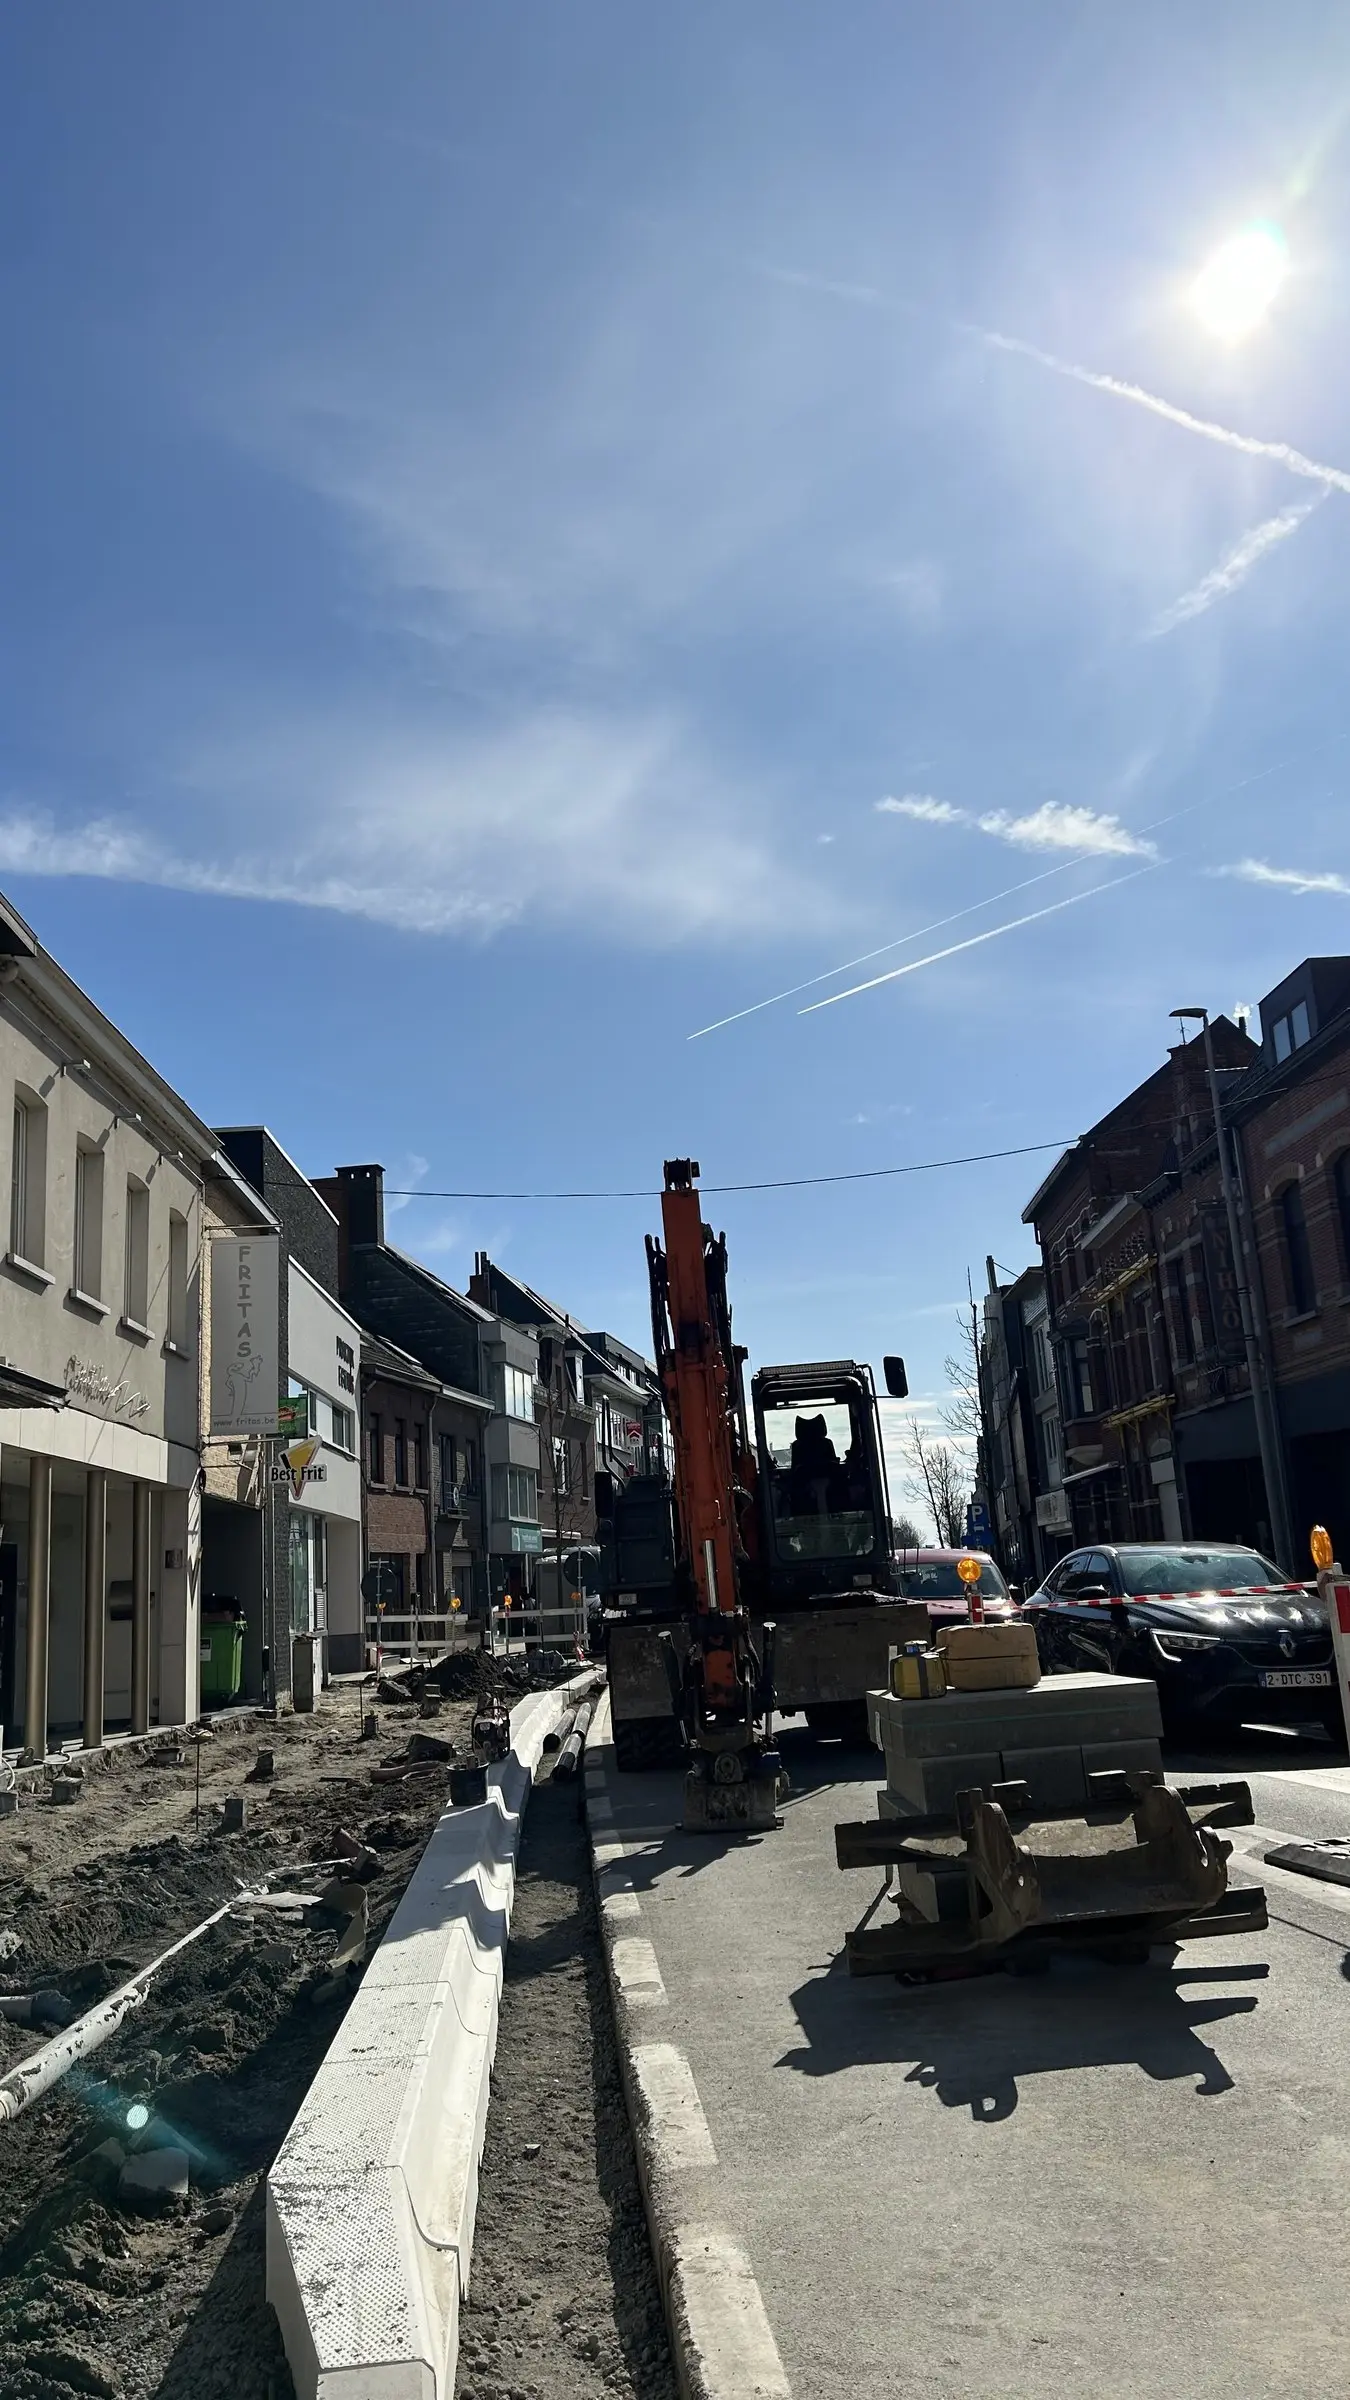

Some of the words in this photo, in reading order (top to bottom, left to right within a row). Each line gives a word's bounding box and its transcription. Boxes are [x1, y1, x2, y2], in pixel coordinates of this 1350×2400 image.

[236, 1245, 252, 1357] FRITAS
[271, 1467, 297, 1481] Best
[301, 1466, 324, 1481] Frit
[971, 1505, 983, 1522] P
[1267, 1673, 1328, 1686] 2-DTC-391
